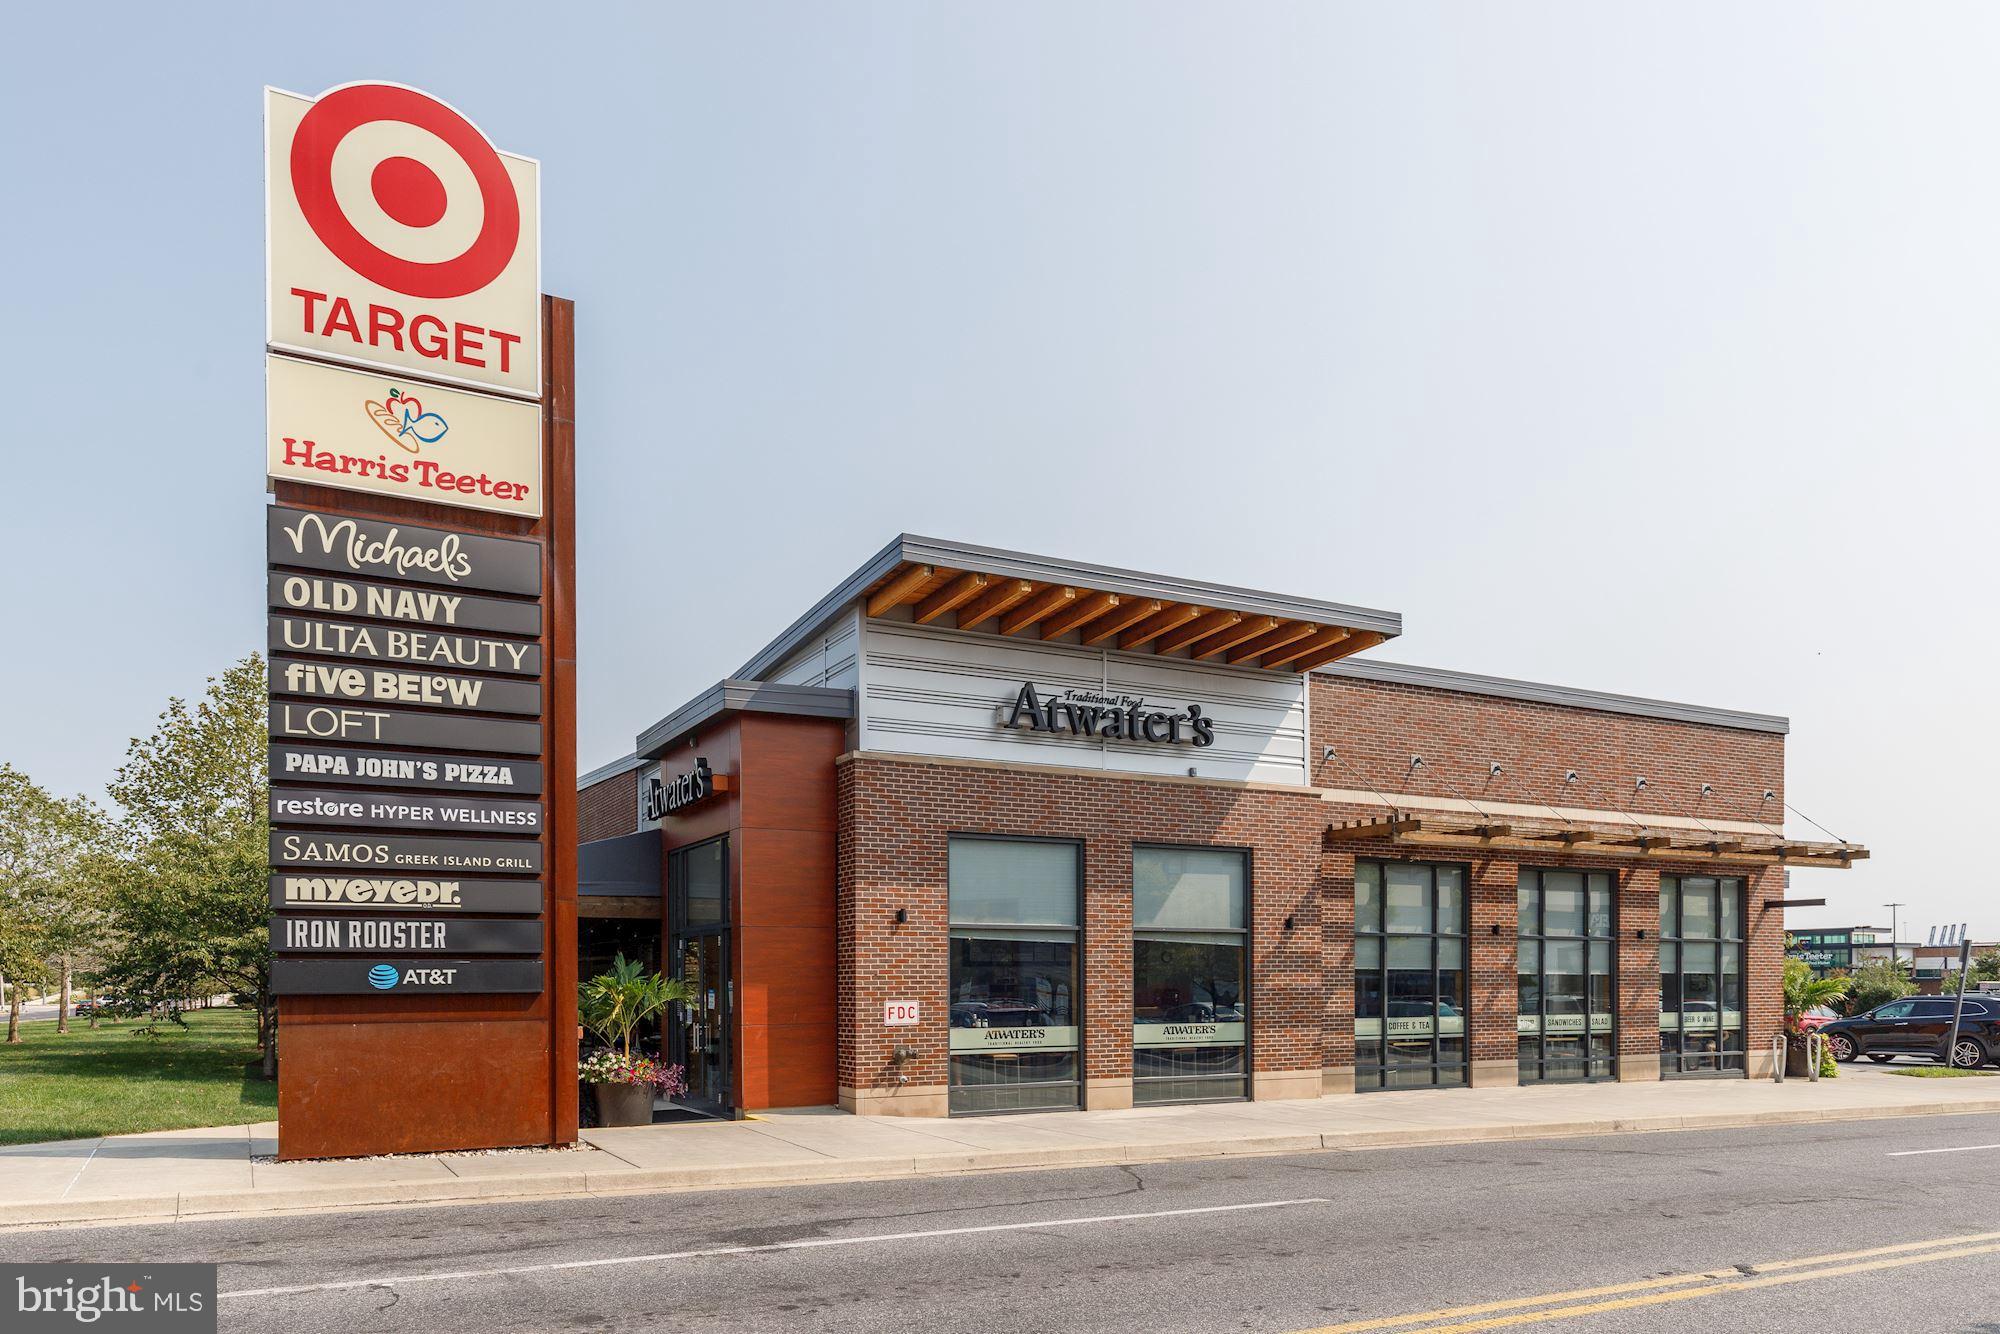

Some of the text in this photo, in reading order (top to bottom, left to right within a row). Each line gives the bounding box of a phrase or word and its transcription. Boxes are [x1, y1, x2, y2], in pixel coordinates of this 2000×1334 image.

[290, 287, 520, 373] TARGET
[281, 438, 529, 501] Harris Teeter
[283, 513, 471, 581] Michaels
[283, 577, 461, 624] OLD NAVY
[283, 619, 529, 670] ULTA BEAUTY
[285, 663, 366, 697] five
[1003, 681, 1215, 747] Atwater's
[1063, 690, 1144, 708] Traditional Food
[285, 705, 390, 739] LOFT
[285, 753, 514, 785] PAPA JOHN'S PIZZA
[647, 757, 710, 820] Atwater's
[277, 797, 537, 825] restore HYPER WELLNESS
[283, 836, 533, 868] SAMOS GREEK ISLAND GRILL
[286, 919, 446, 949] IRON ROOSTER
[402, 968, 457, 985] AT&T
[888, 1006, 915, 1020] FDC
[1388, 1022, 1409, 1030] COFFEE
[1419, 1021, 1430, 1029] TEA
[1547, 1018, 1608, 1027] SANDWICHES SALAD
[1703, 1015, 1714, 1023] WINE
[984, 1028, 1045, 1040] ATWATER'S
[1163, 1025, 1216, 1035] ATWATER'S
